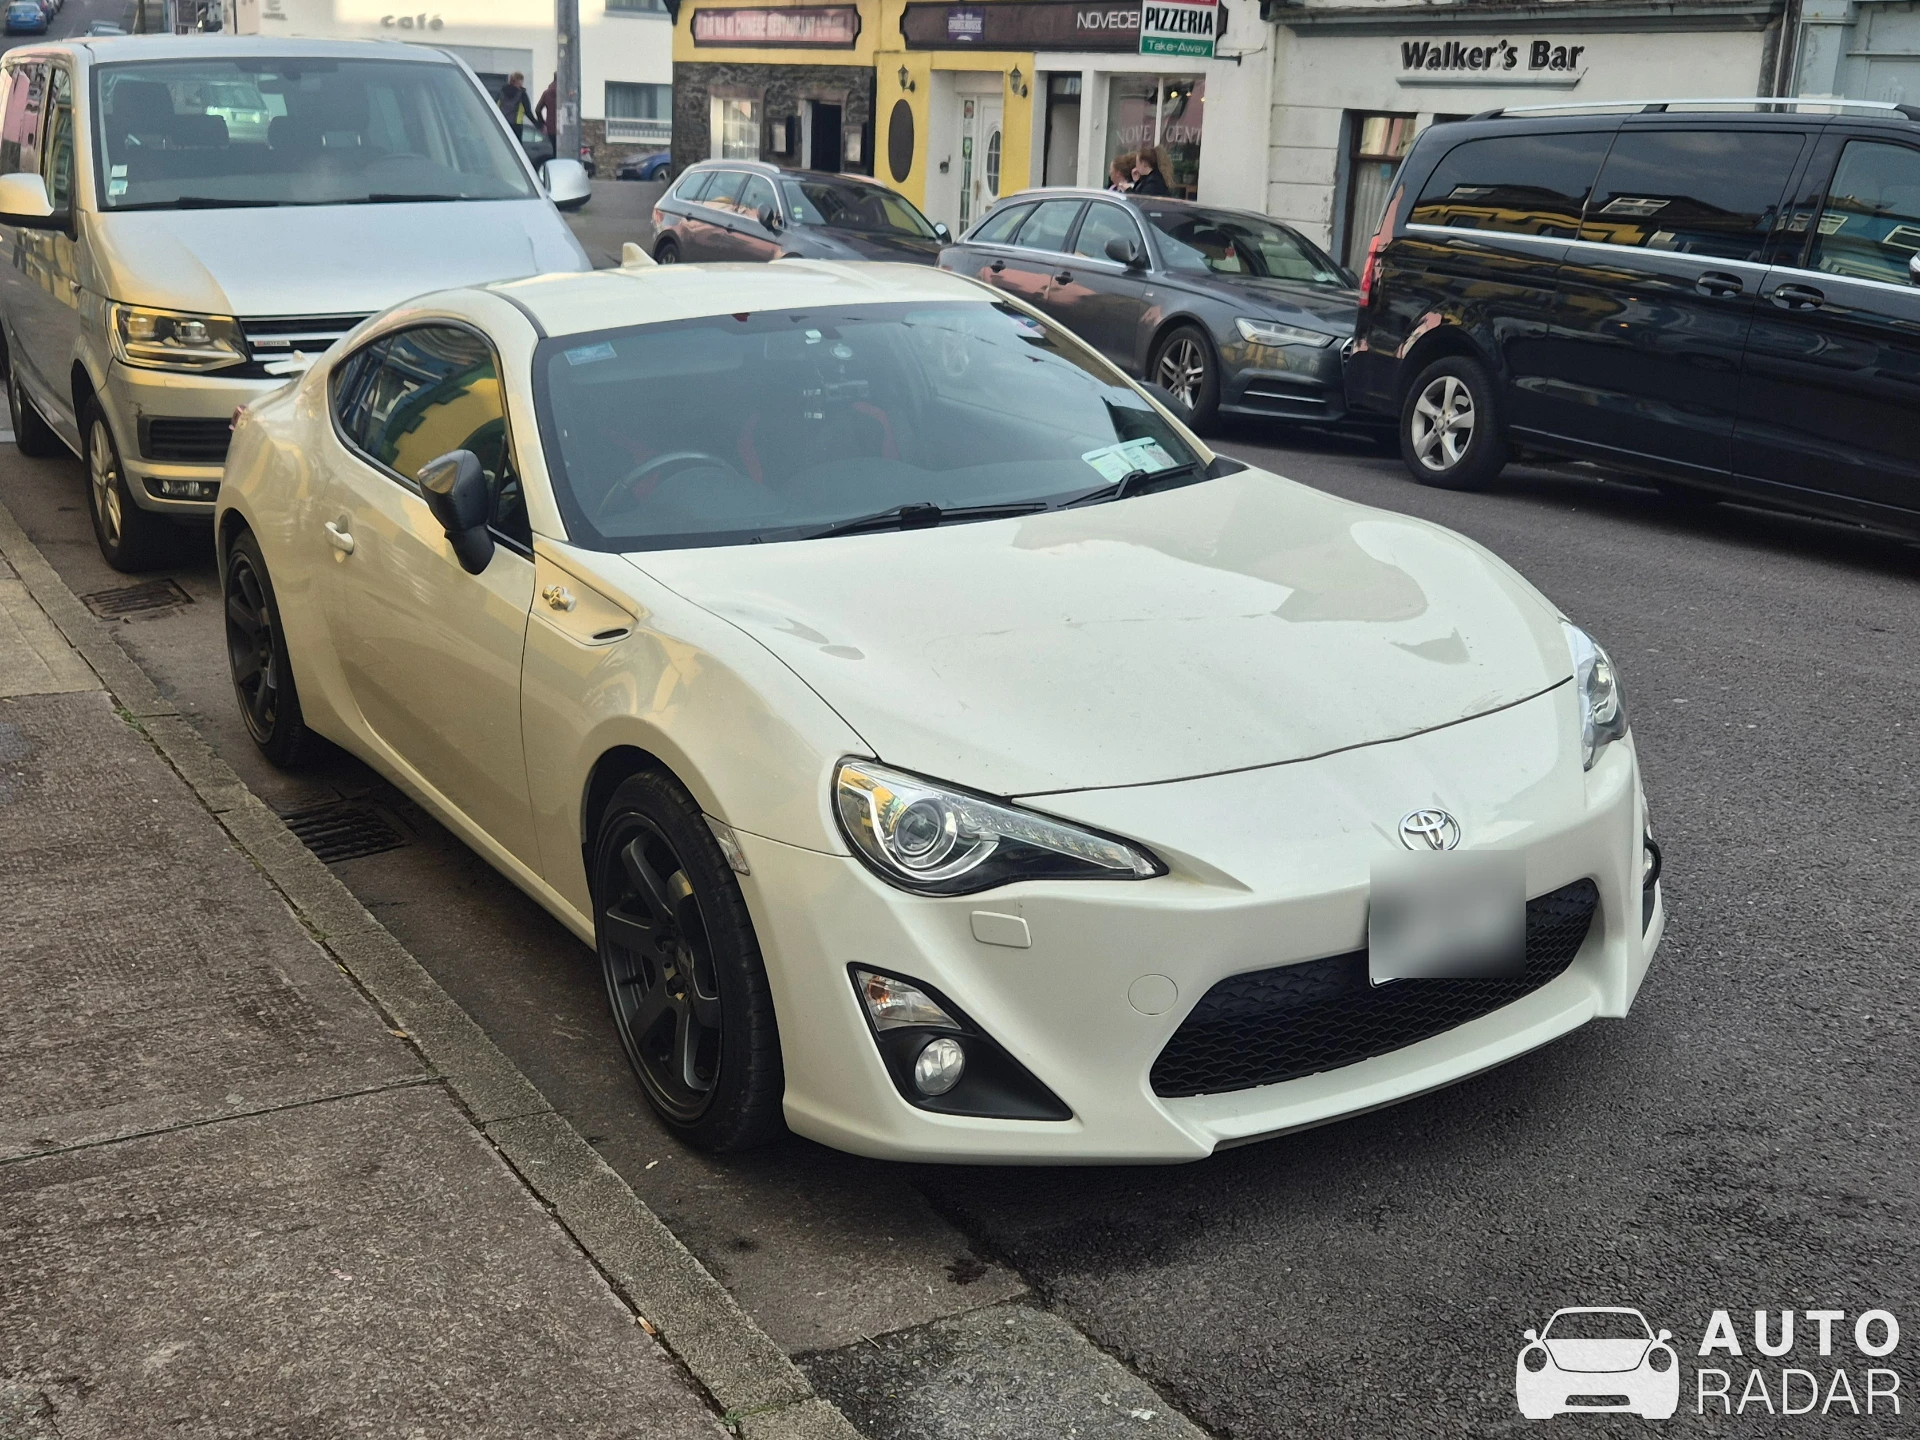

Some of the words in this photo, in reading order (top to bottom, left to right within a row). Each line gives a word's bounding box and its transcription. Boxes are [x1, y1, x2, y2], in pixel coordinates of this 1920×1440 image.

[1144, 7, 1213, 35] PIZZERIA
[1147, 40, 1207, 55] Take-Away
[1401, 39, 1518, 71] Walker's
[1528, 40, 1585, 71] Bar
